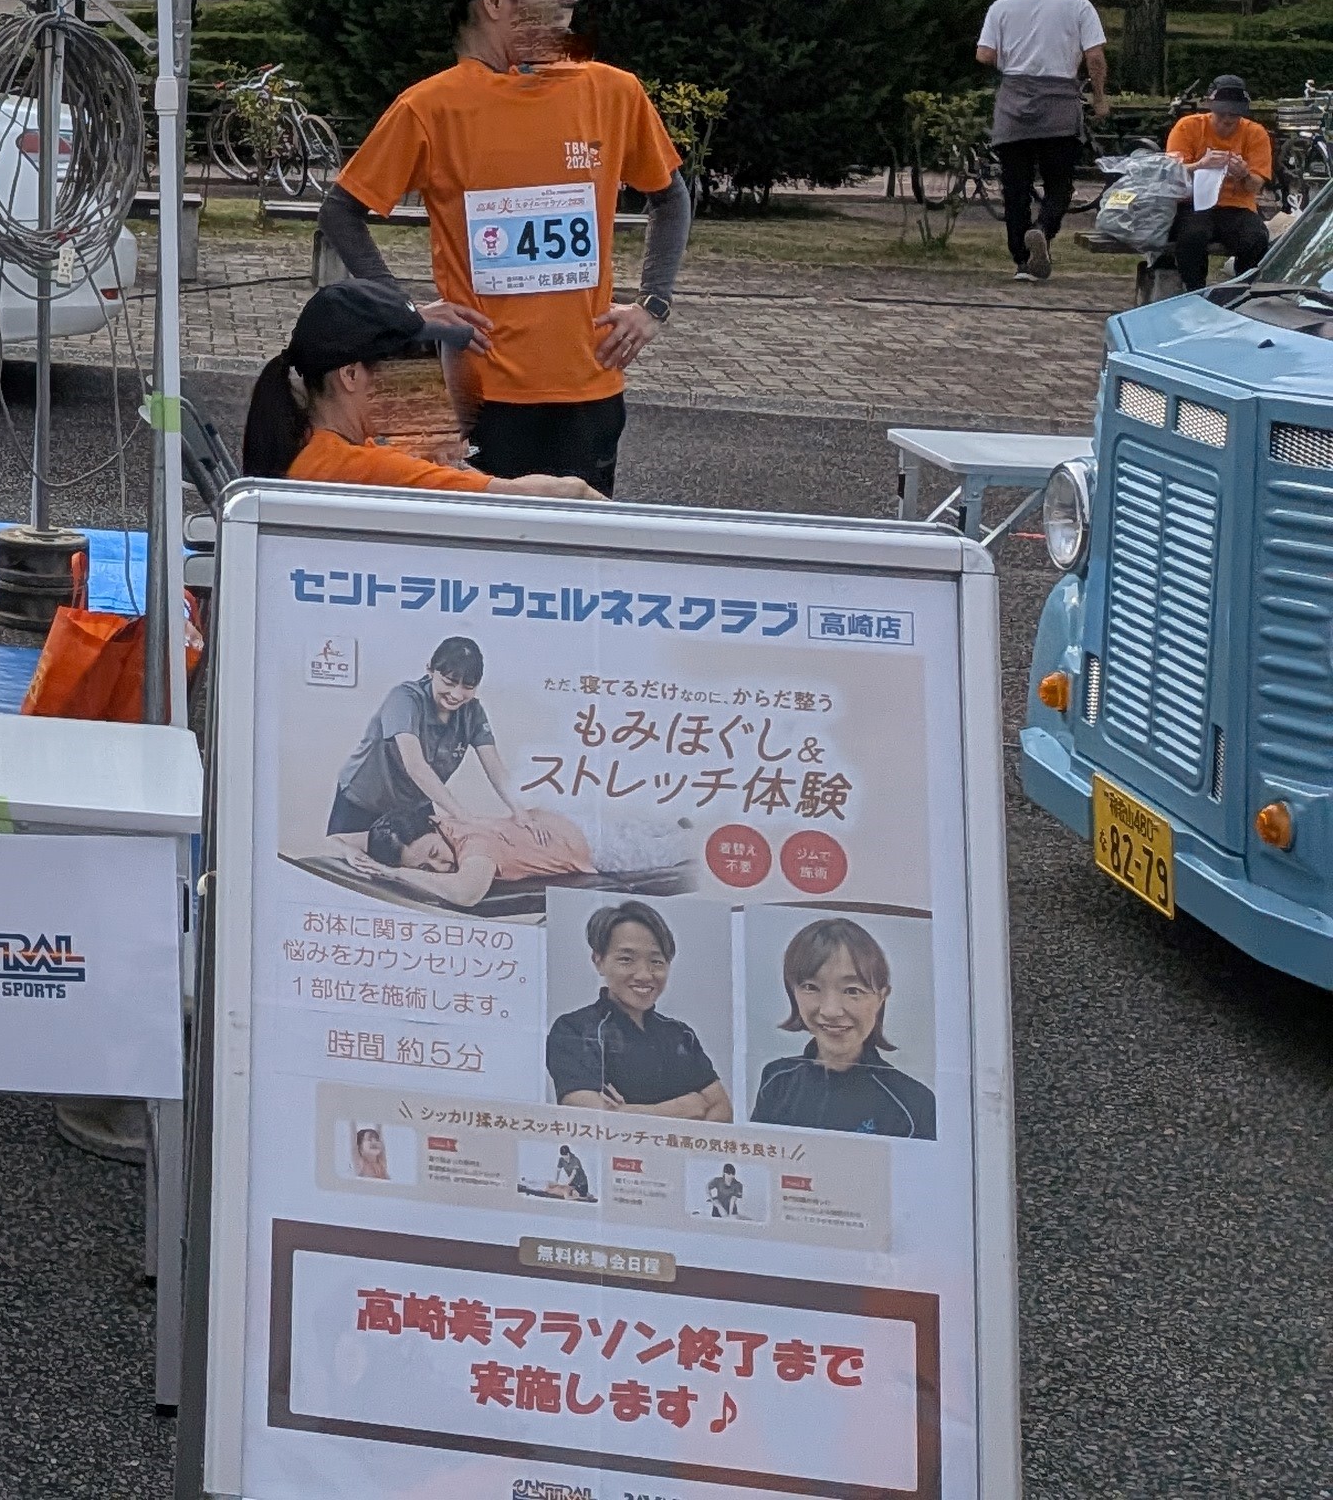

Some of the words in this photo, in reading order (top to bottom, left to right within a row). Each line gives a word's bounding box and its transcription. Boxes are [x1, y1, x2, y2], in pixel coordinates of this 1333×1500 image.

[516, 217, 592, 262] 458
[290, 567, 479, 614] セントラル
[489, 583, 798, 638] ウェルネスクラブ
[818, 610, 901, 641] 高崎店
[520, 753, 853, 821] ストレッチ体験
[1110, 824, 1169, 907] 82-79
[302, 910, 514, 952] お体に関する日々の
[283, 938, 529, 984] 悩みをカウンセリング。
[1, 980, 67, 1000] SPORTS
[327, 1029, 386, 1062] 時間
[535, 1244, 662, 1276] 無料体験会日程
[356, 1287, 867, 1389] 高崎美マラソン終了まで
